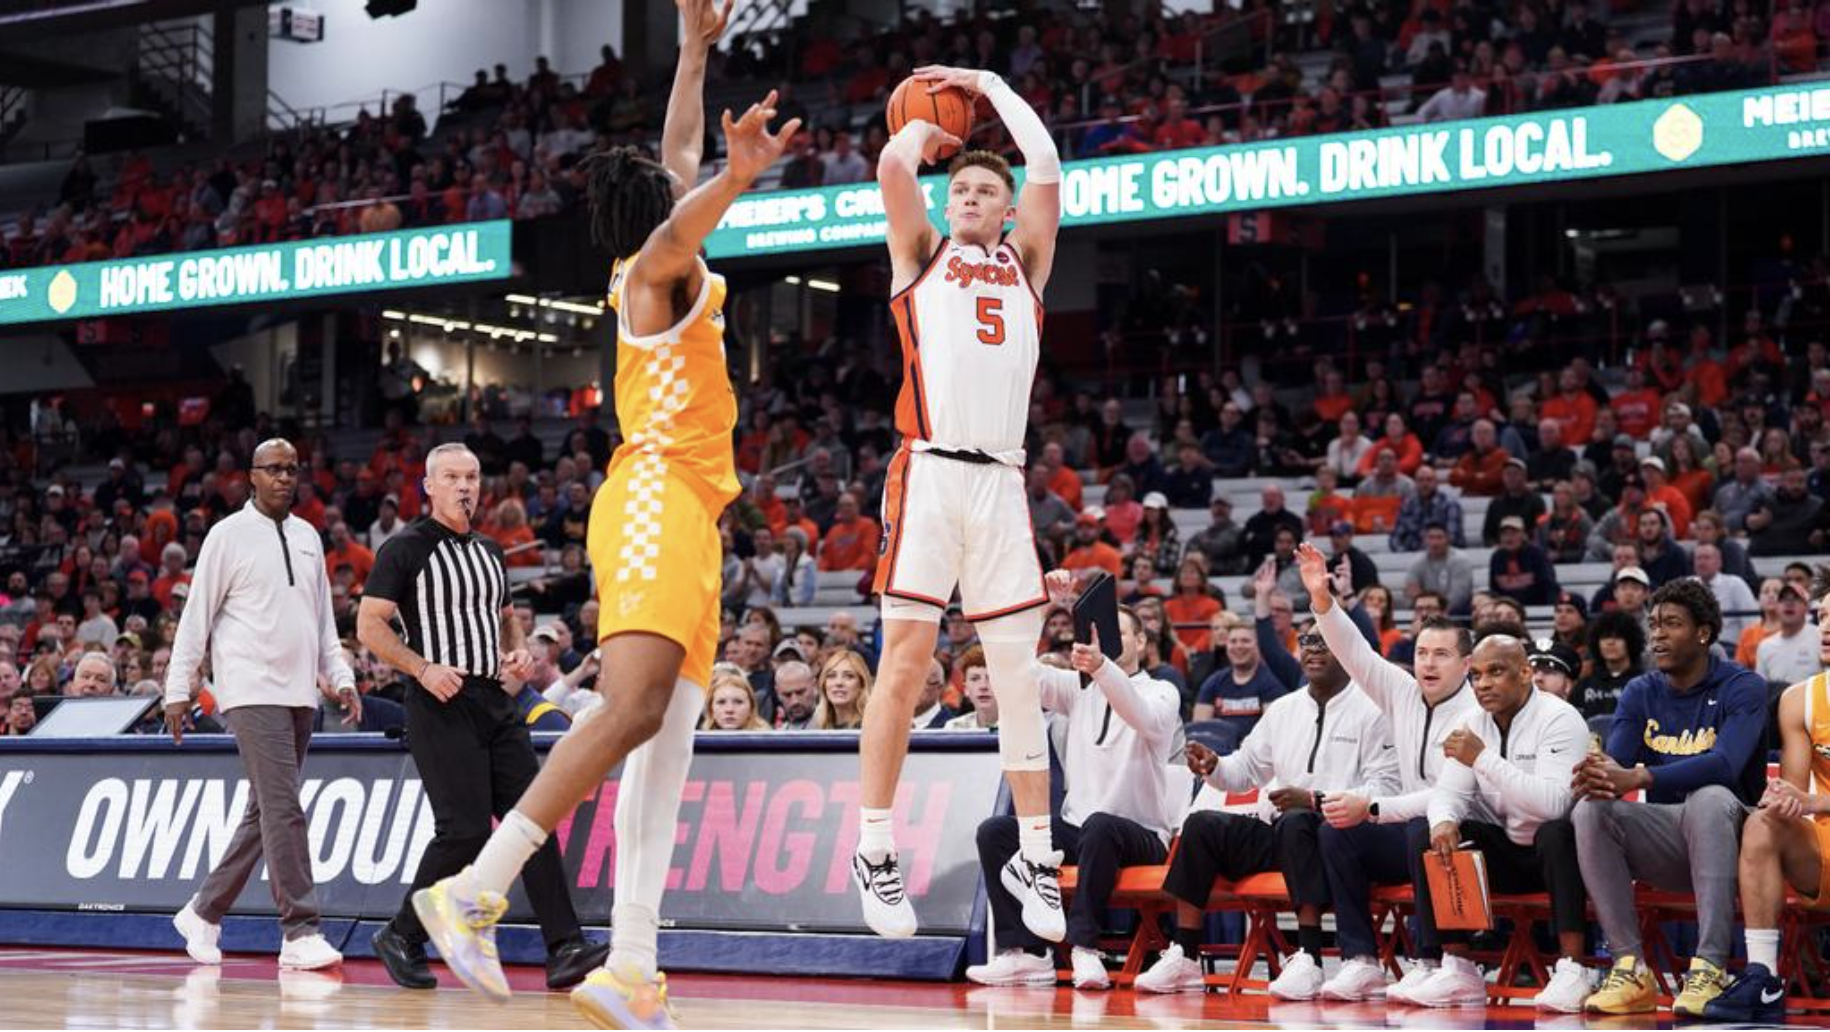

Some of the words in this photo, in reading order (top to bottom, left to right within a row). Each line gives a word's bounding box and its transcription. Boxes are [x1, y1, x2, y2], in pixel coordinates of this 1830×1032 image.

[1788, 127, 1830, 149] BRE
[1060, 163, 1144, 217] OME
[1152, 147, 1309, 208] GROWN.
[1320, 131, 1450, 193] DRINK
[1460, 117, 1613, 180] LOCAL.
[835, 183, 935, 218] CRK
[819, 221, 888, 242] COMPAN
[100, 261, 174, 308] HOME
[179, 250, 289, 300] GROWN.
[295, 239, 385, 290] DRINK
[389, 230, 496, 282] LOCAL.
[976, 296, 1006, 346] 5
[66, 777, 250, 880] OWN
[261, 777, 437, 885] OU
